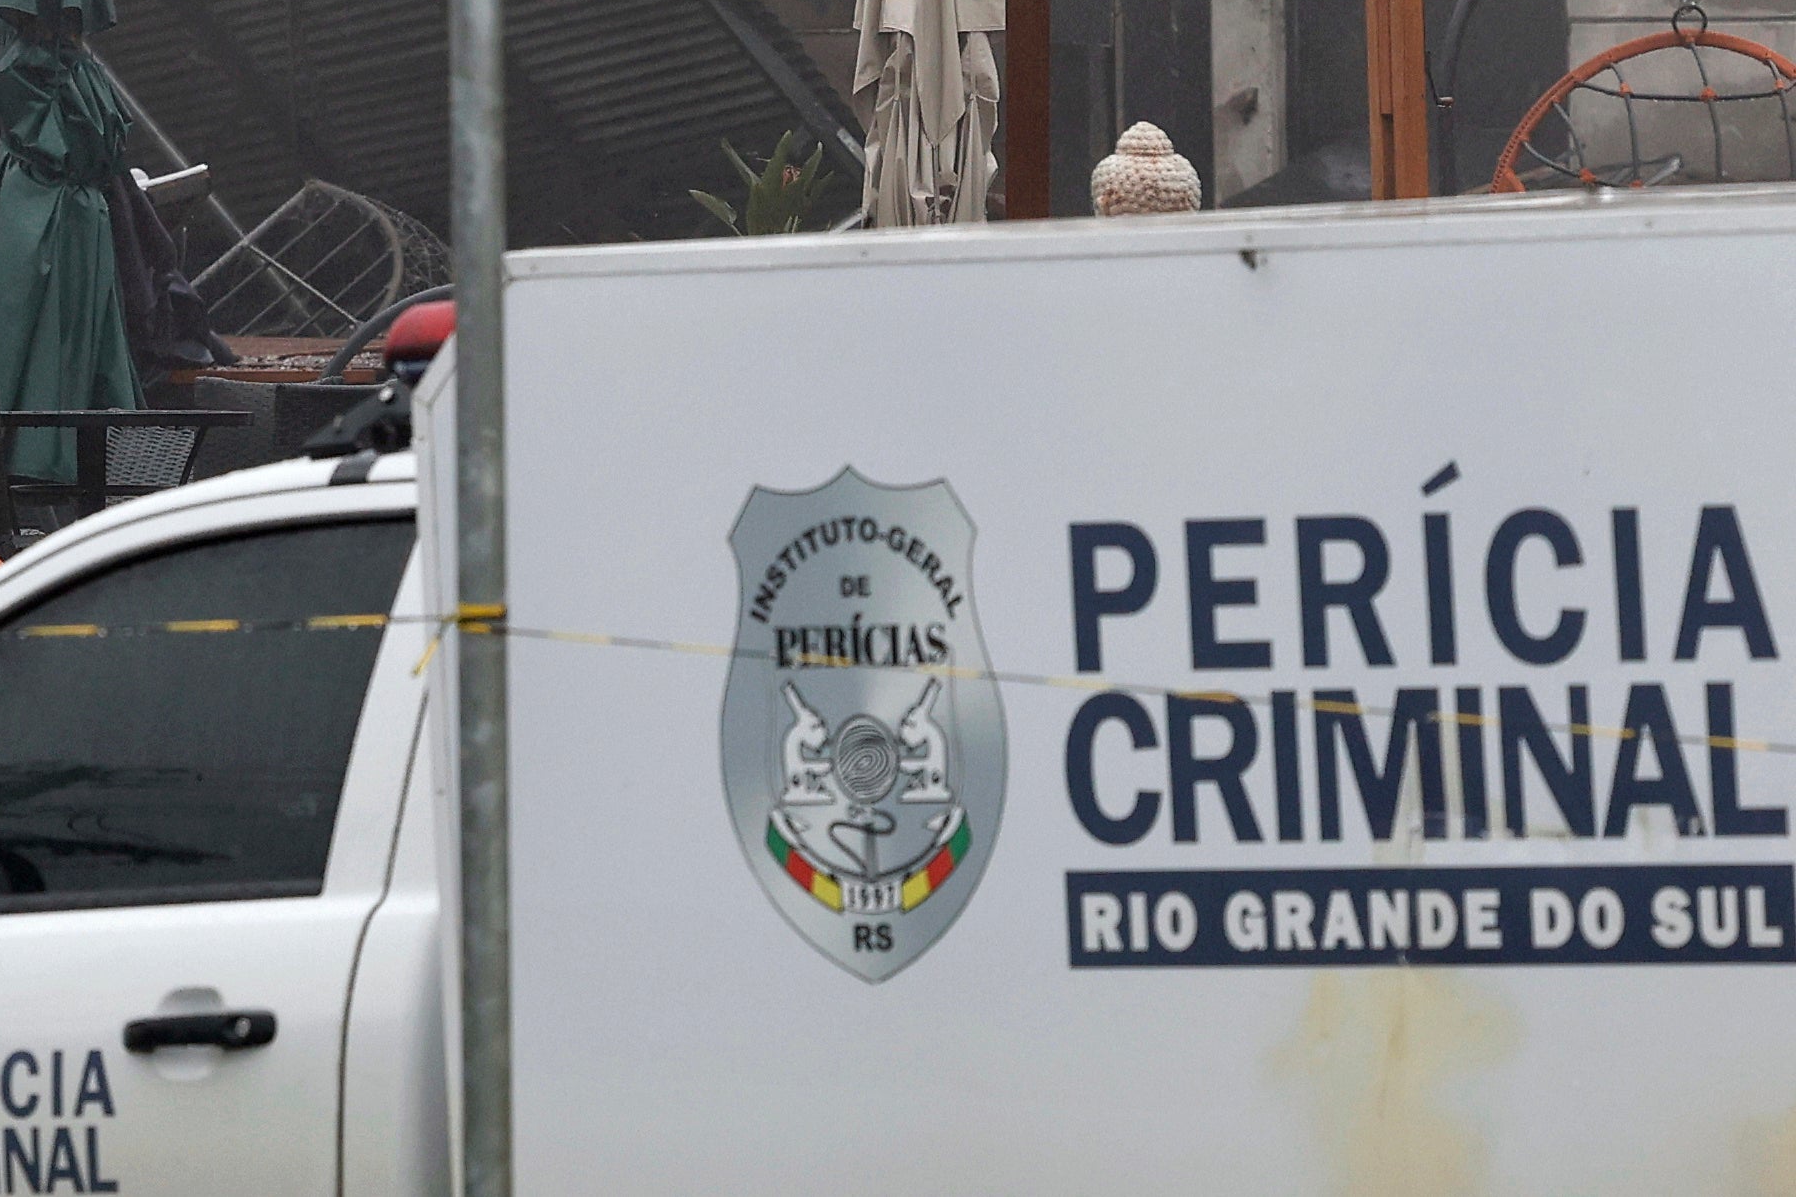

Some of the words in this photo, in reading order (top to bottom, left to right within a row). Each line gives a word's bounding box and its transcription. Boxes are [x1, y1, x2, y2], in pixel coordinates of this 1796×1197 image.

[748, 514, 964, 625] INSTITUTO-GERAL
[839, 574, 873, 600] DE
[1068, 460, 1780, 673] PERÍCIA
[774, 612, 948, 669] PERÍCIAS
[1065, 680, 1790, 847] CRIMINAL
[853, 924, 895, 953] RS
[1080, 890, 1199, 954] RIO
[1223, 889, 1503, 953] GRANDE
[1529, 887, 1626, 950] DO
[1650, 884, 1784, 949] SUL
